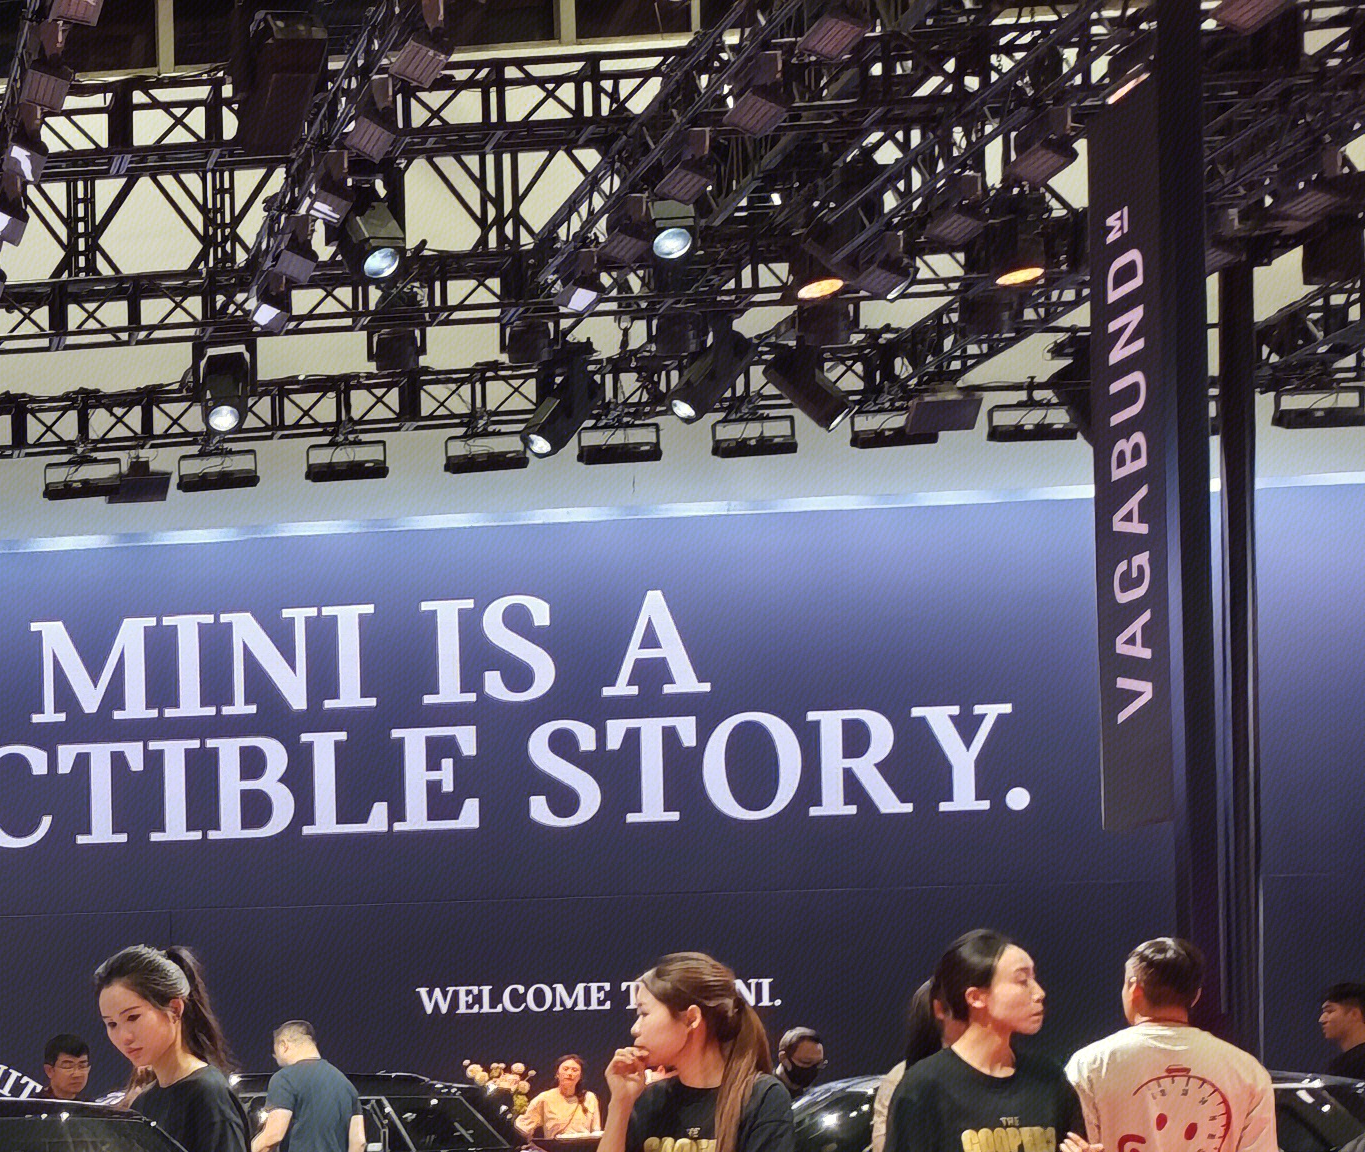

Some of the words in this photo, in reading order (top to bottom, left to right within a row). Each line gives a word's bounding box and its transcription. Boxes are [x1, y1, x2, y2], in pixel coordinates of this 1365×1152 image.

[1105, 247, 1154, 725] VAGABUND
[29, 602, 377, 725] MINI
[420, 593, 557, 706] IS
[600, 589, 712, 698] A
[526, 702, 1032, 828] STORY.
[415, 982, 611, 1015] WELCOME
